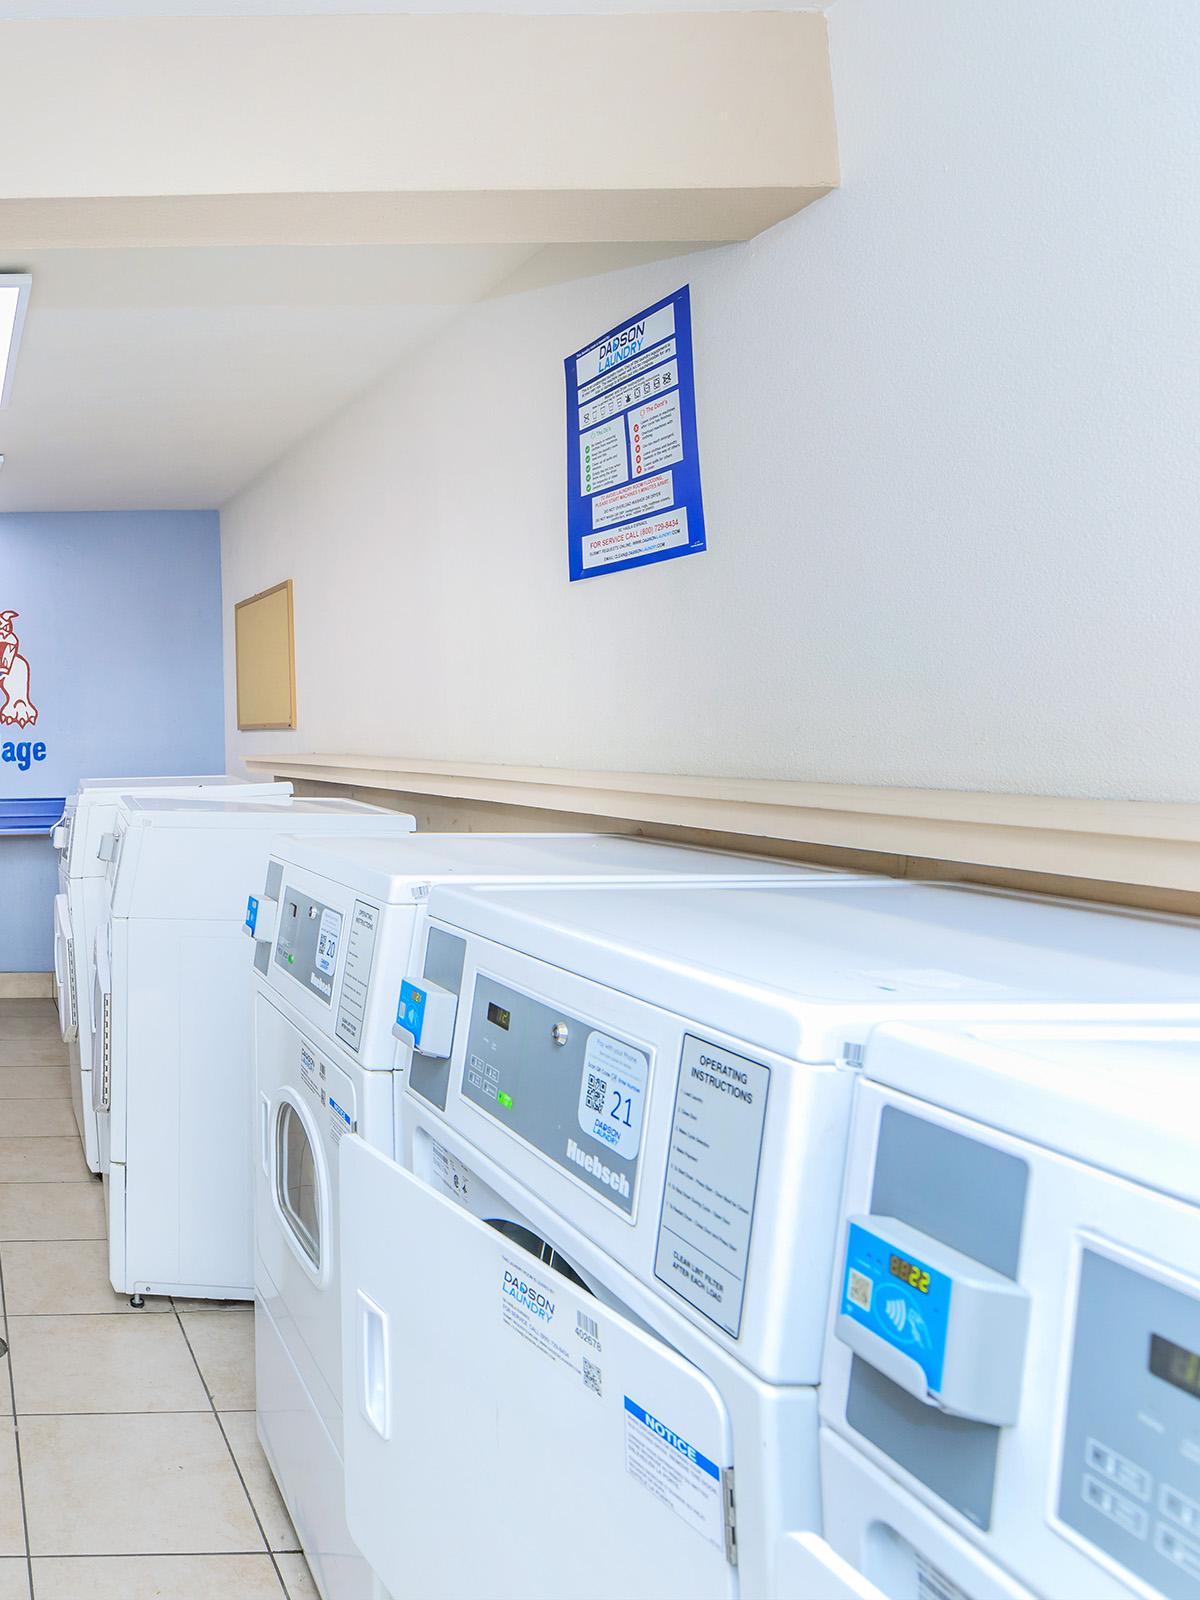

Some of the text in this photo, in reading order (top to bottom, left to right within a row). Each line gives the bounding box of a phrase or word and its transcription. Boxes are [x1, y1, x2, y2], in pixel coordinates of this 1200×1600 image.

[598, 338, 644, 374] LAUNDRY
[600, 322, 646, 360] DADSON
[590, 540, 600, 549] FOR
[602, 533, 623, 546] SERVICE
[625, 529, 638, 539] CALL
[639, 525, 653, 537] (800)
[654, 518, 678, 532] 729-8434
[327, 940, 335, 958] 20
[691, 1068, 752, 1104] INSTRUCTIONS
[700, 1054, 747, 1084] OPERATING
[610, 1090, 633, 1128] 21
[595, 1118, 622, 1140] DADSON
[566, 1138, 630, 1199] Huebsch
[672, 1260, 721, 1303] AFTER EACH LOAD
[673, 1250, 723, 1293] CLEAN LINT FILTER
[502, 1282, 552, 1324] LAUNDRY
[504, 1270, 555, 1314] DADSON
[645, 1412, 697, 1464] NOTICE
